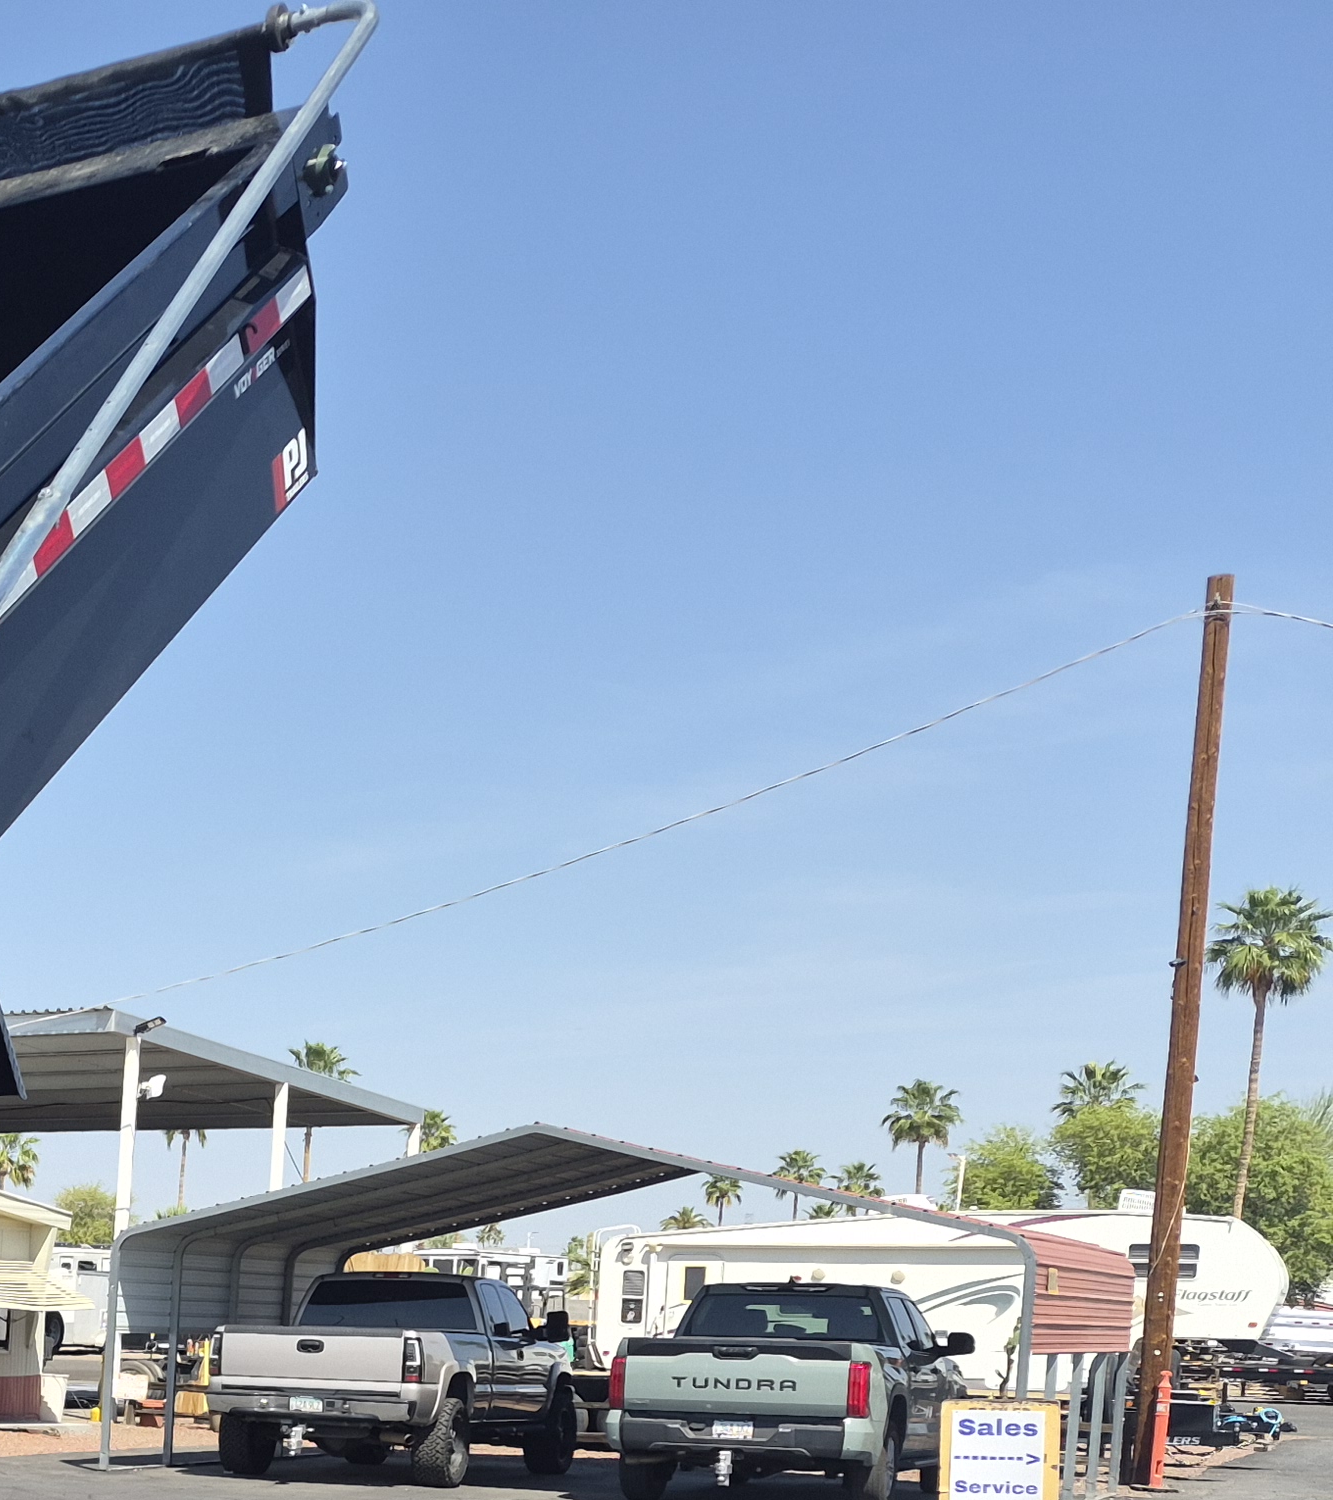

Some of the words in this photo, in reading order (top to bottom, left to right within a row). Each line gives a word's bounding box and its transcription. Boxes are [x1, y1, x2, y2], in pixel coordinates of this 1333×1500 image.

[282, 427, 308, 491] PJ
[671, 1376, 797, 1392] TUNDRA
[958, 1418, 1039, 1437] Sales
[954, 1480, 1039, 1495] Service
